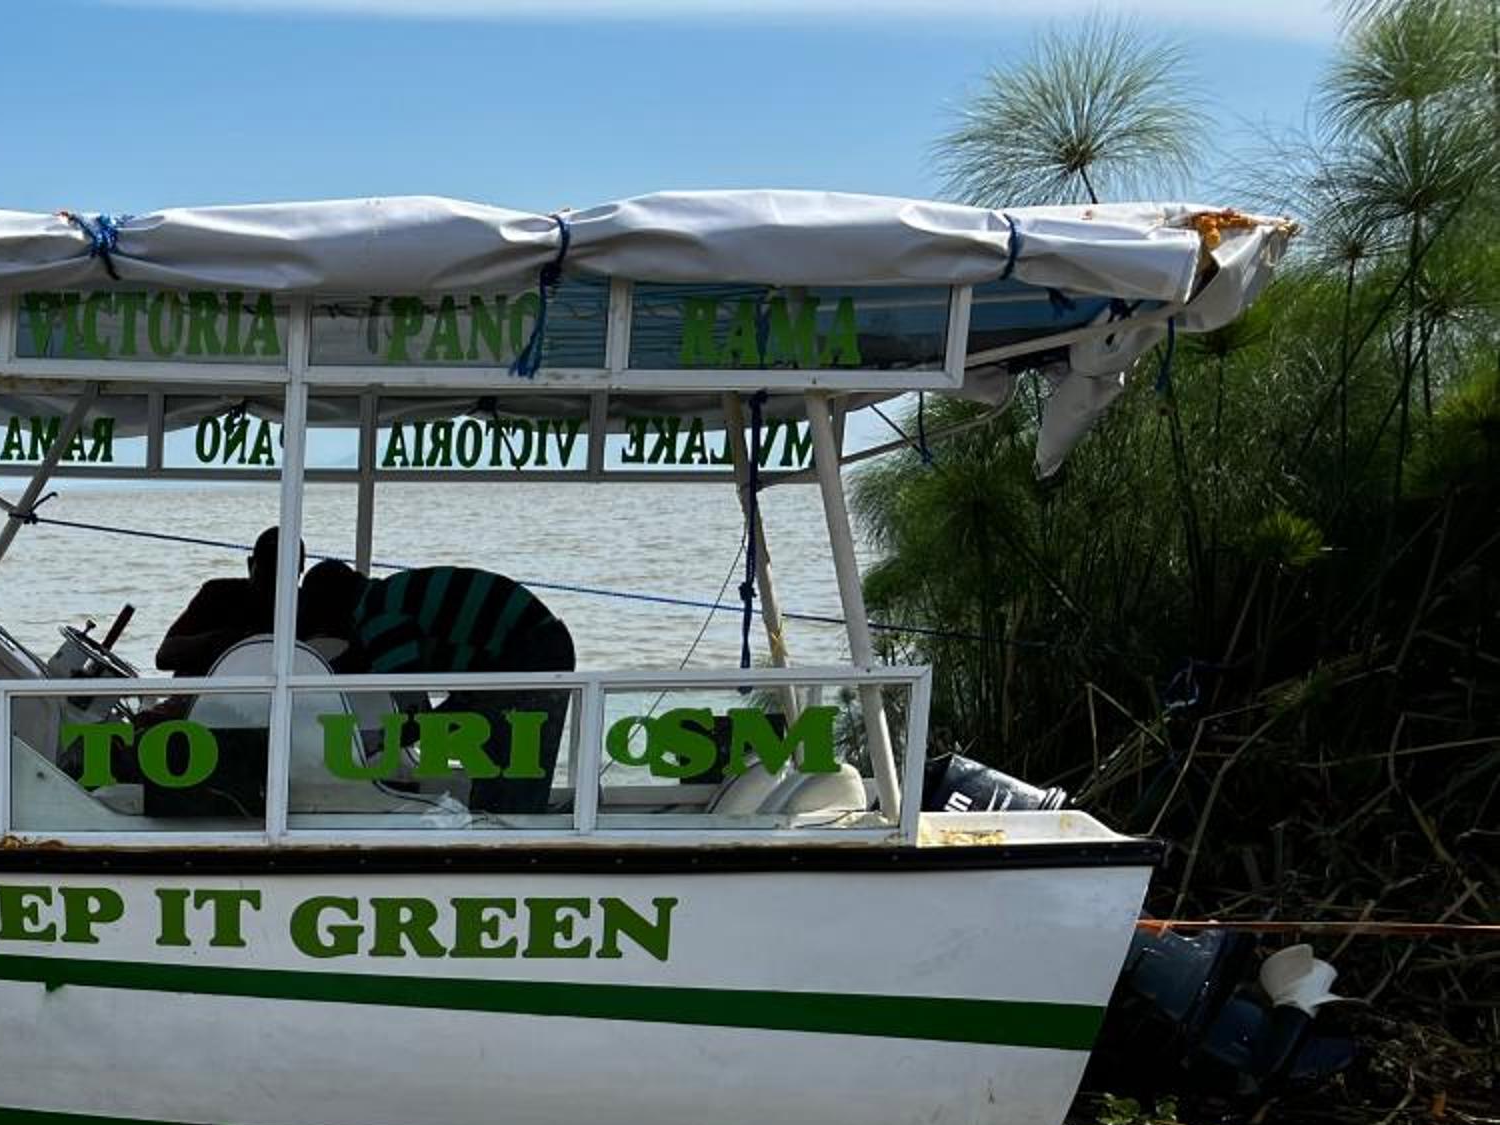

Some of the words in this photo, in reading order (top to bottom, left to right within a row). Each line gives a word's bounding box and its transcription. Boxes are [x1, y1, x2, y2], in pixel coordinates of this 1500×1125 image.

[24, 290, 281, 358] VICTORIA
[680, 296, 862, 366] RAMA
[59, 720, 219, 788] TO
[155, 888, 262, 948] IT
[290, 896, 679, 963] GREEN
